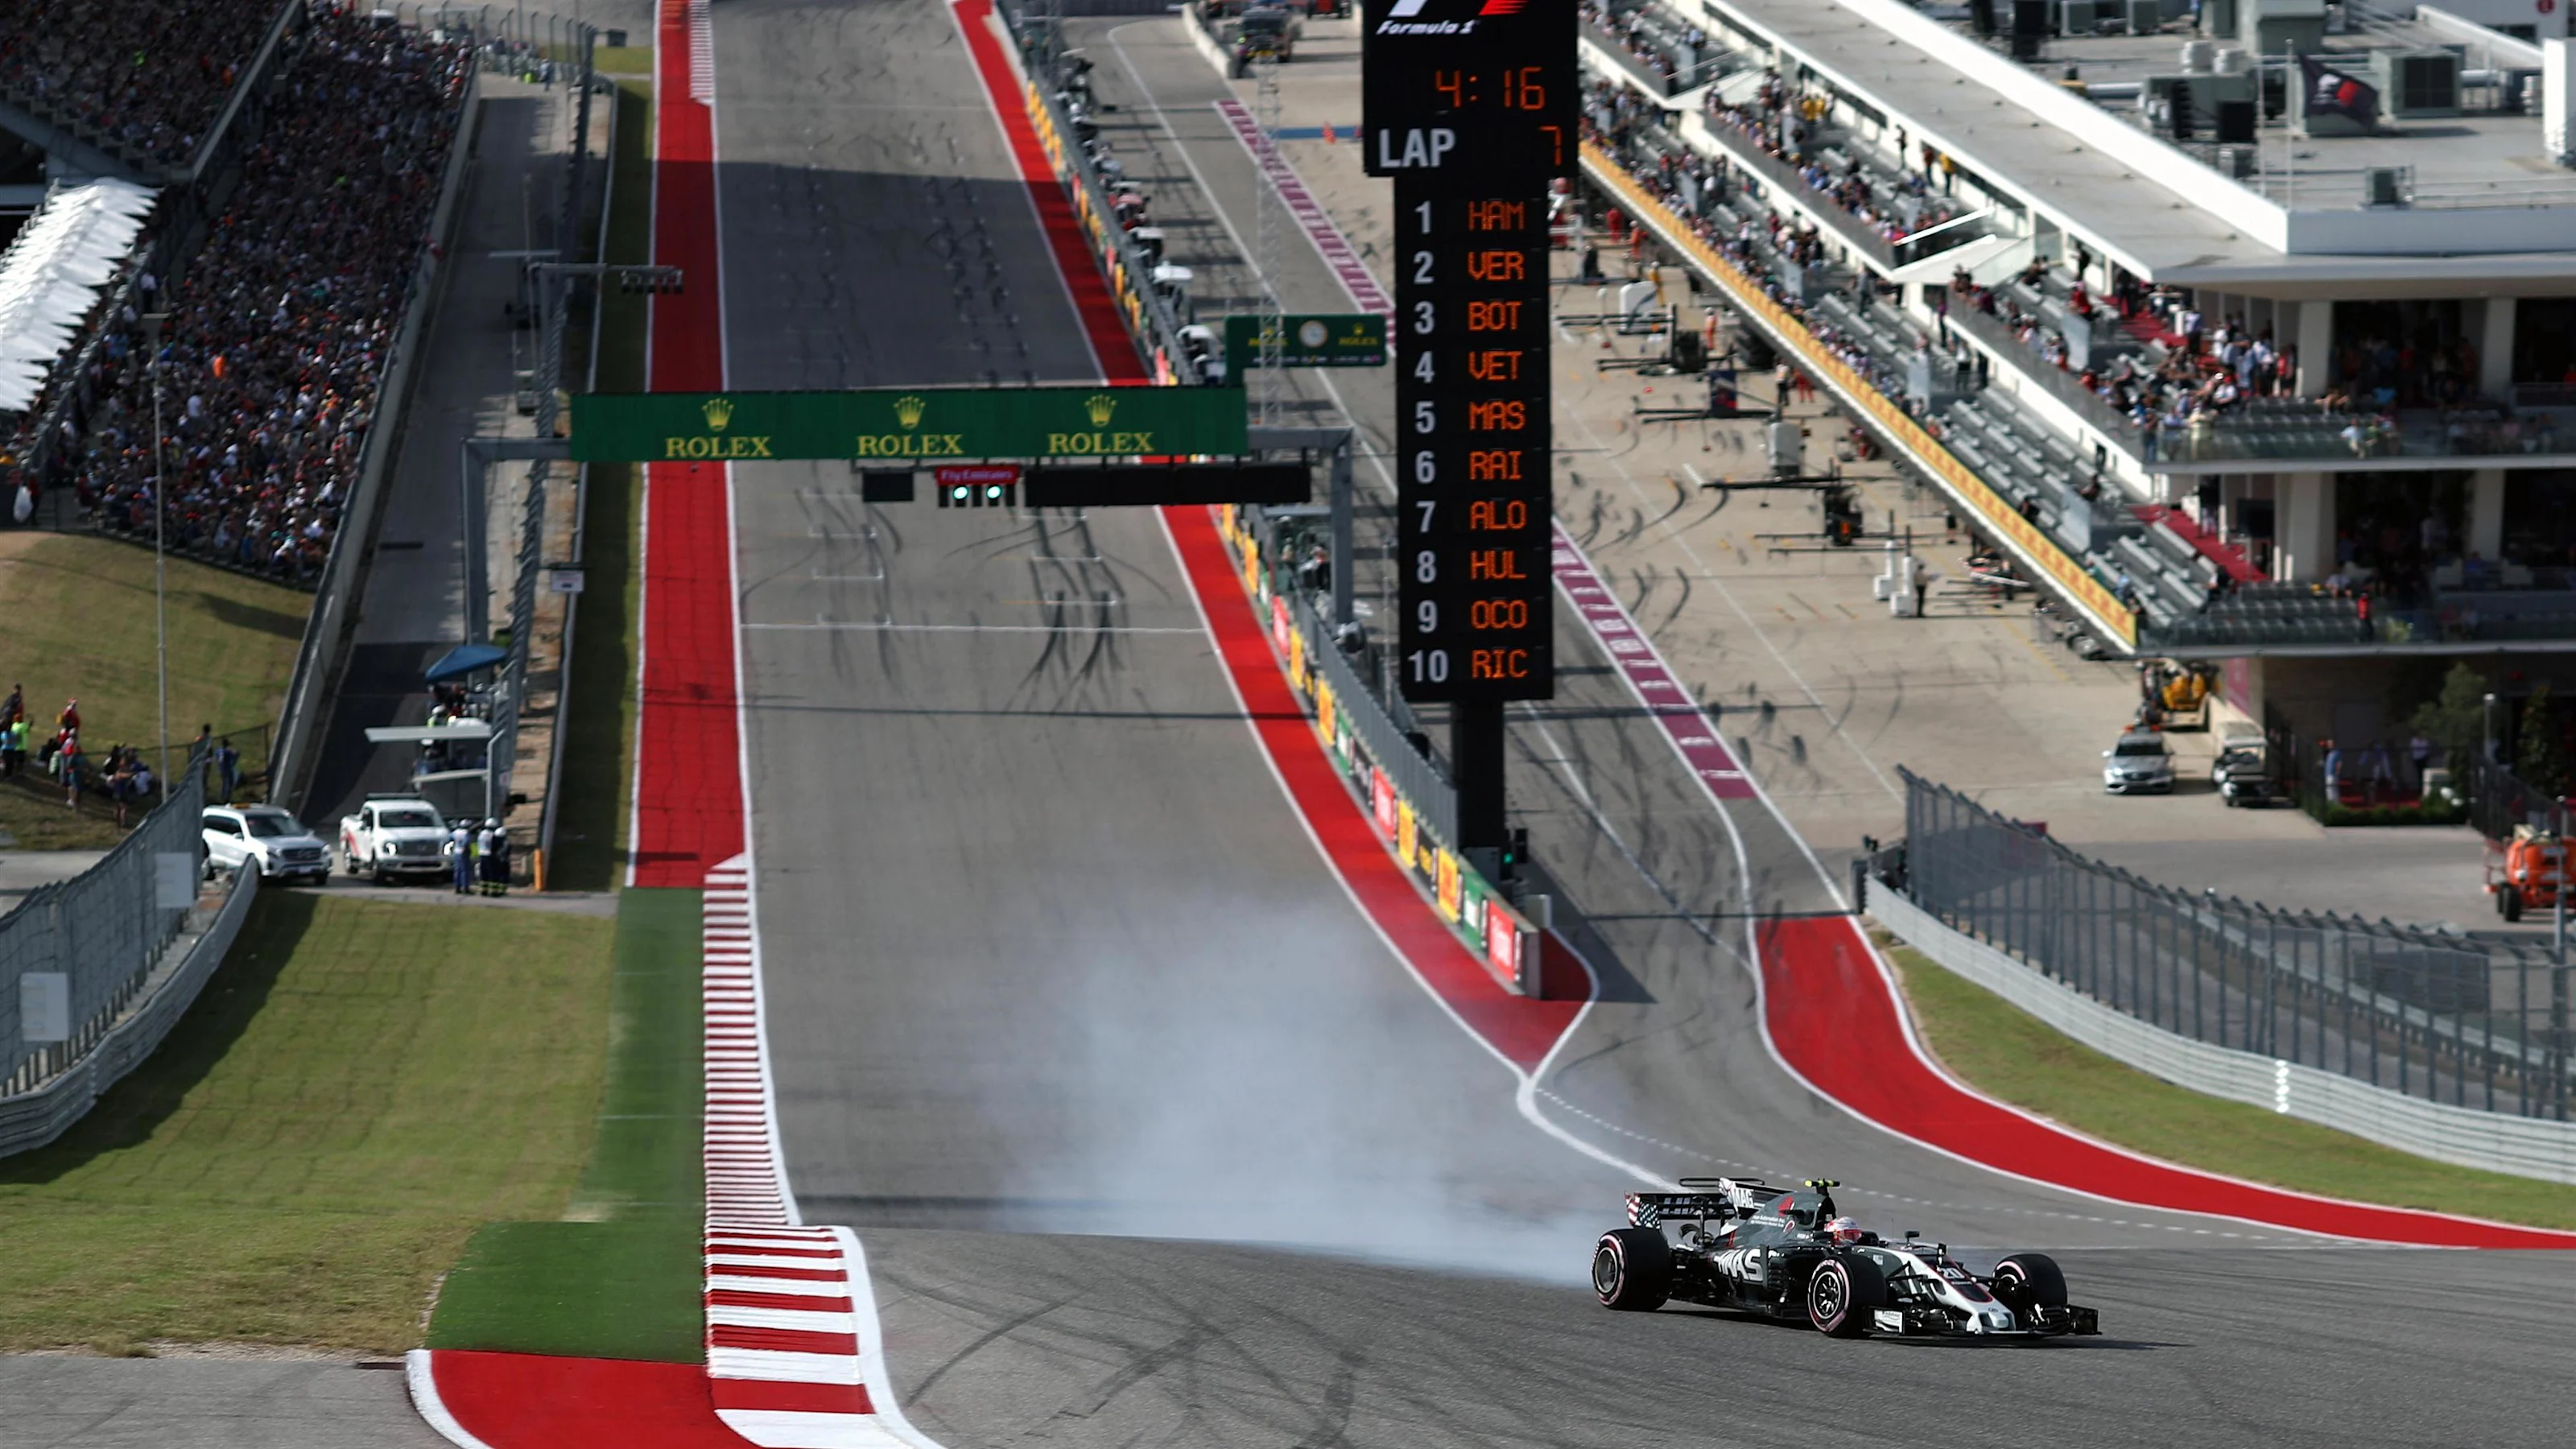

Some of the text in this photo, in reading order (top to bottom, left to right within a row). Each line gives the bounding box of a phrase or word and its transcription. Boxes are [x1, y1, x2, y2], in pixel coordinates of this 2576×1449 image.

[1376, 19, 1475, 35] Formula 1
[1435, 66, 1546, 110] 4:16
[1378, 126, 1563, 169] LAP 7
[1414, 200, 1525, 234] 1 HAM
[1414, 250, 1525, 284] 2 VER
[1414, 300, 1523, 335] 3 BOT
[1414, 350, 1524, 384] 4 VET
[1414, 401, 1526, 434] 5 MAS
[665, 436, 773, 458] ROLEX
[857, 434, 965, 456] ROLEX
[1047, 431, 1154, 454] ROLEX
[1414, 450, 1523, 484] 6 RAI
[1415, 500, 1528, 533] 7 ALO
[1416, 550, 1528, 584] 8 HUL
[1417, 599, 1529, 634] 9 OCO
[1409, 649, 1529, 683] 10 RIC
[1939, 1267, 1966, 1279] 20
